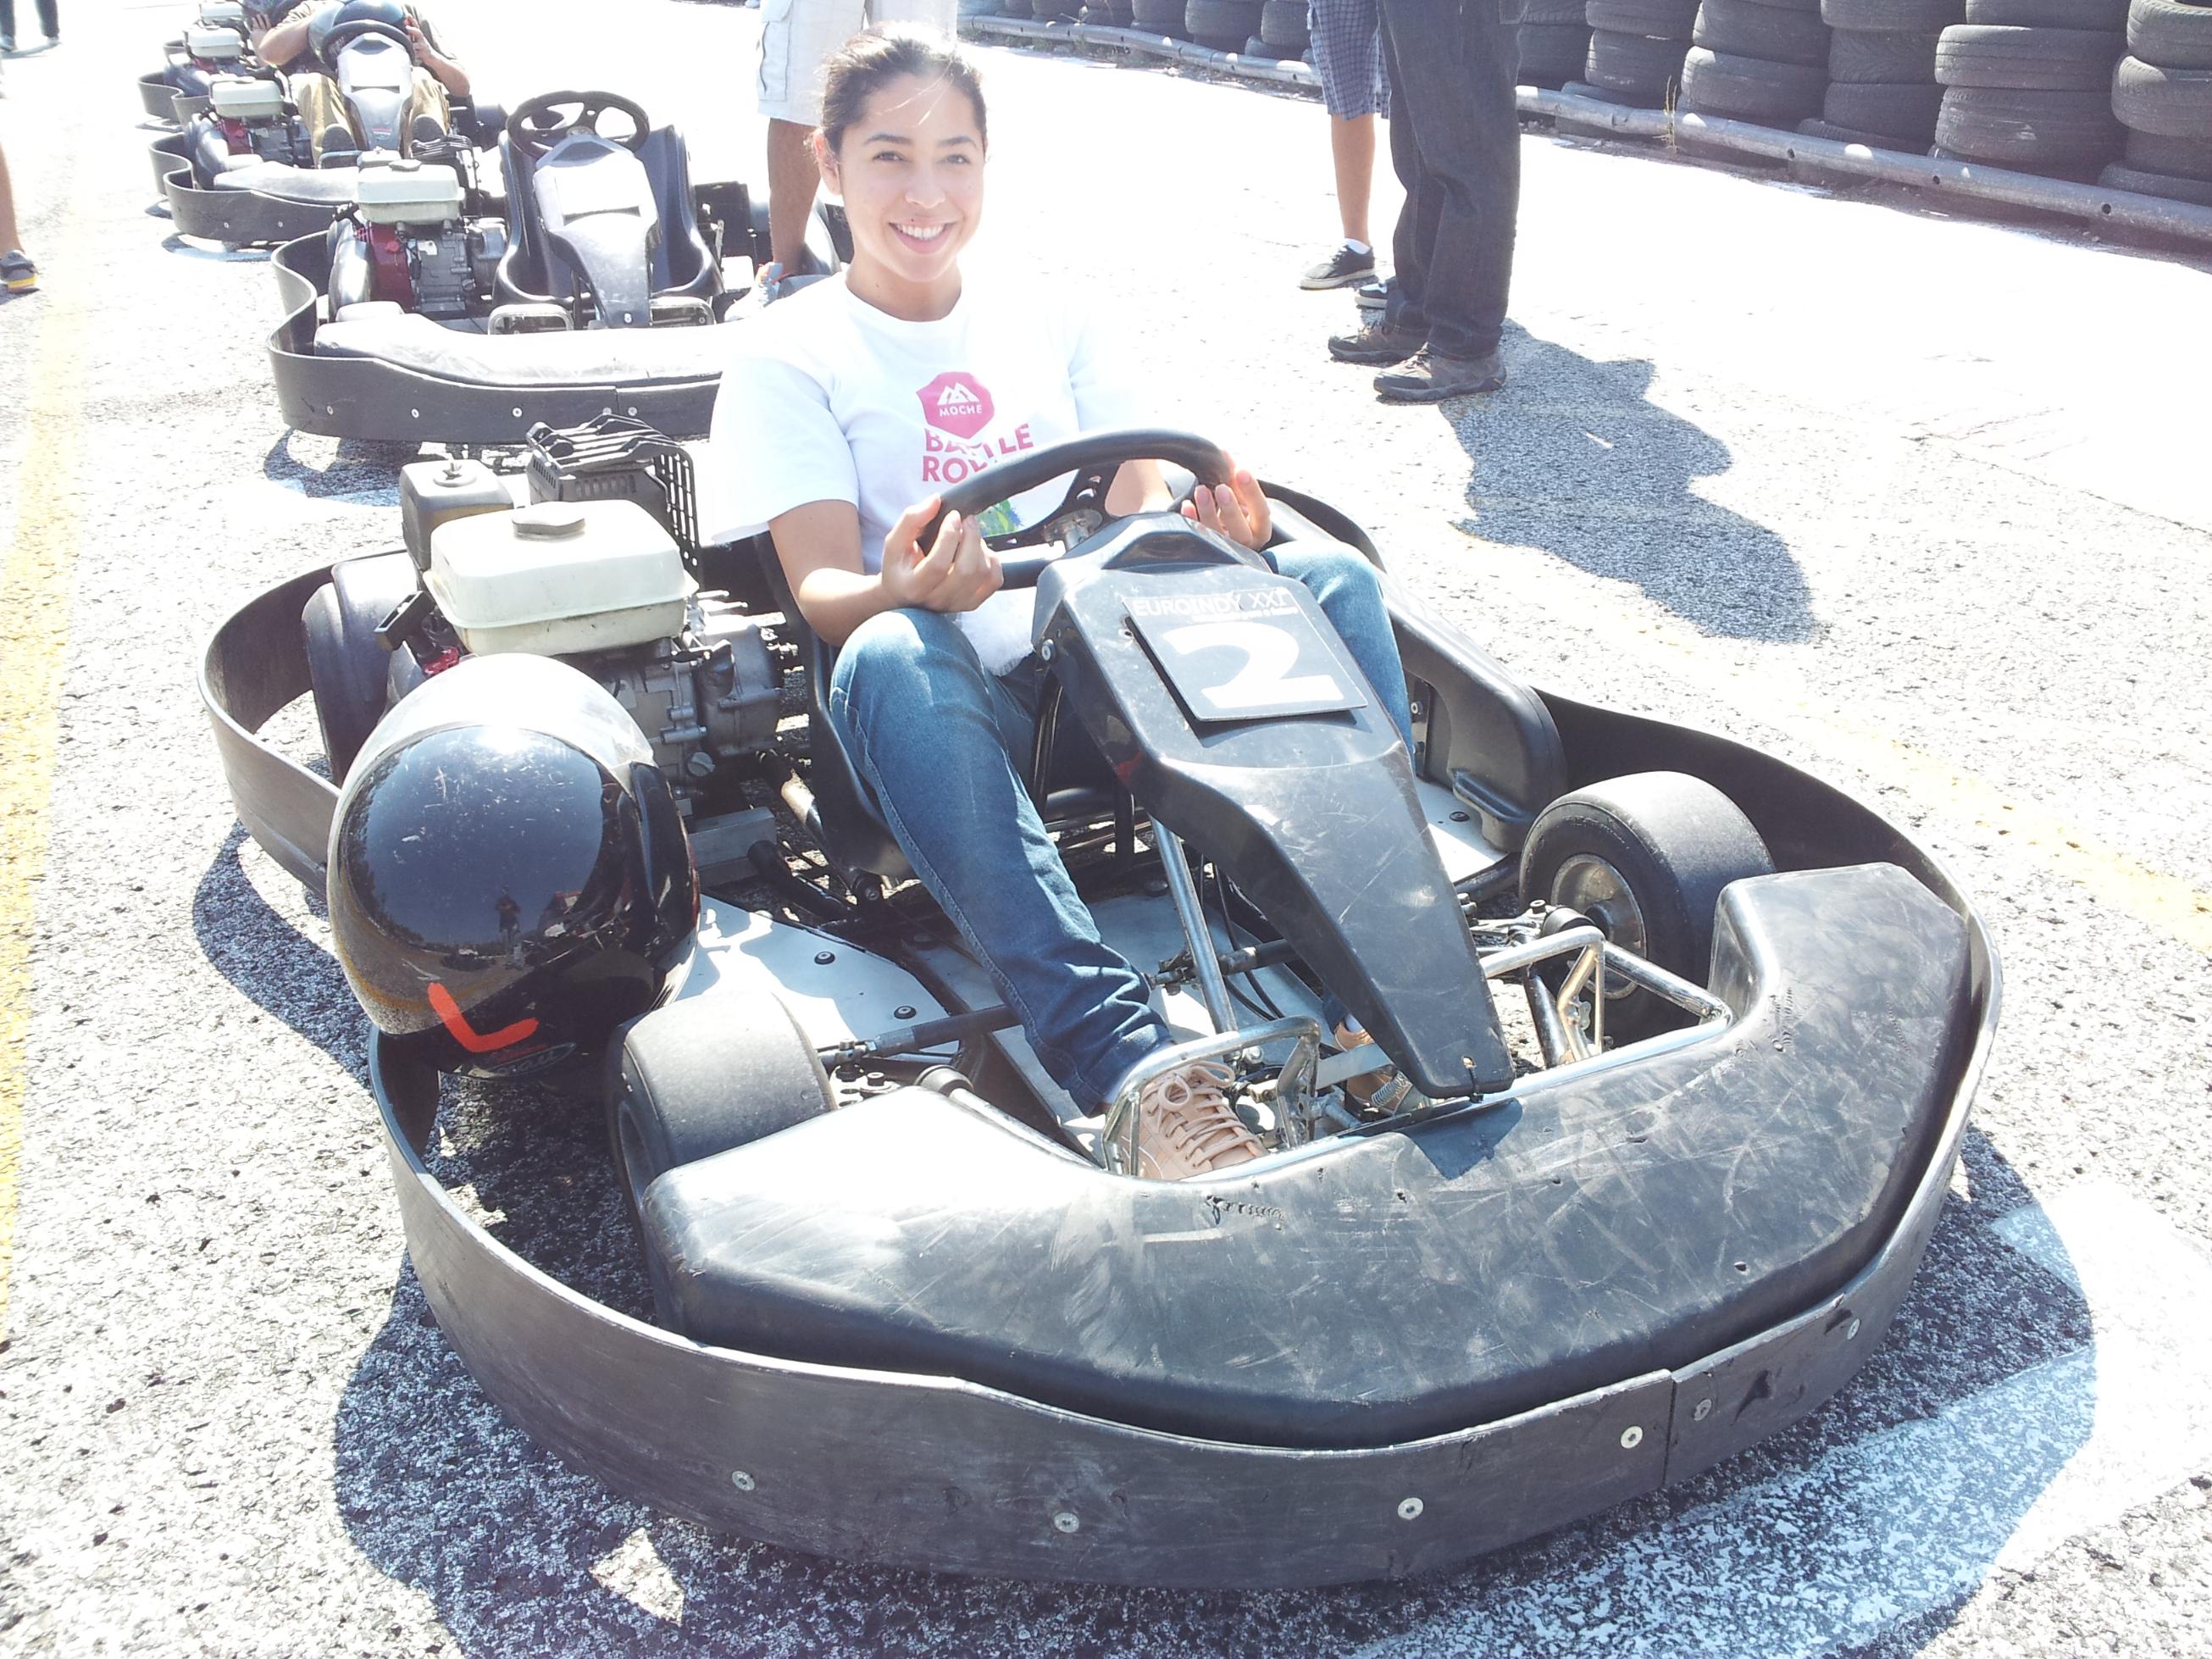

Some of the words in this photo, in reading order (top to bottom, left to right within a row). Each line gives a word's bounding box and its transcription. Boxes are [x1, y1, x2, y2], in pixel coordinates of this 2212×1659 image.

[939, 404, 983, 417] MOCHE
[1132, 593, 1242, 616] EUROINDY
[1162, 621, 1344, 709] 2
